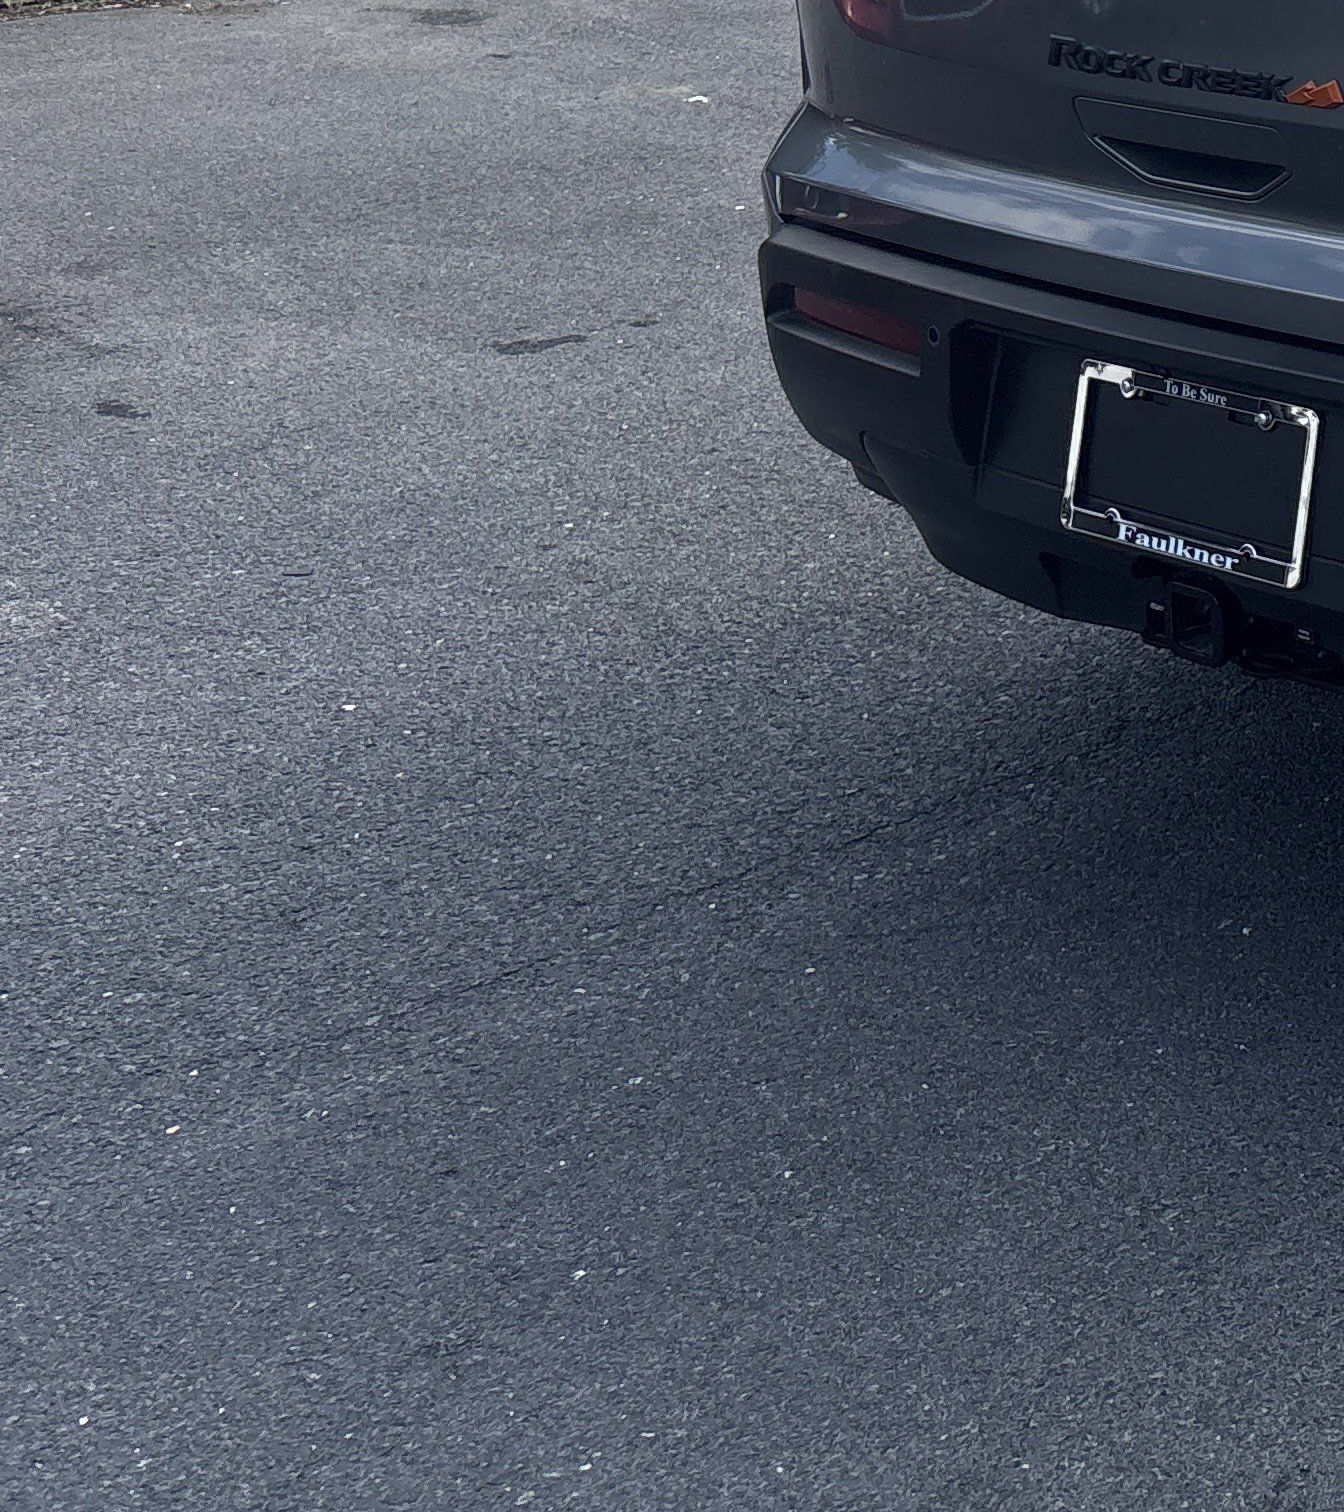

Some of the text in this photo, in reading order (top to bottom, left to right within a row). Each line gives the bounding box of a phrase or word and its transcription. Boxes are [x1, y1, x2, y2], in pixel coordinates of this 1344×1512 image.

[1048, 33, 1294, 104] ROCK CREEK
[1163, 379, 1228, 406] To Be Sure
[1116, 522, 1239, 571] Faulkner
